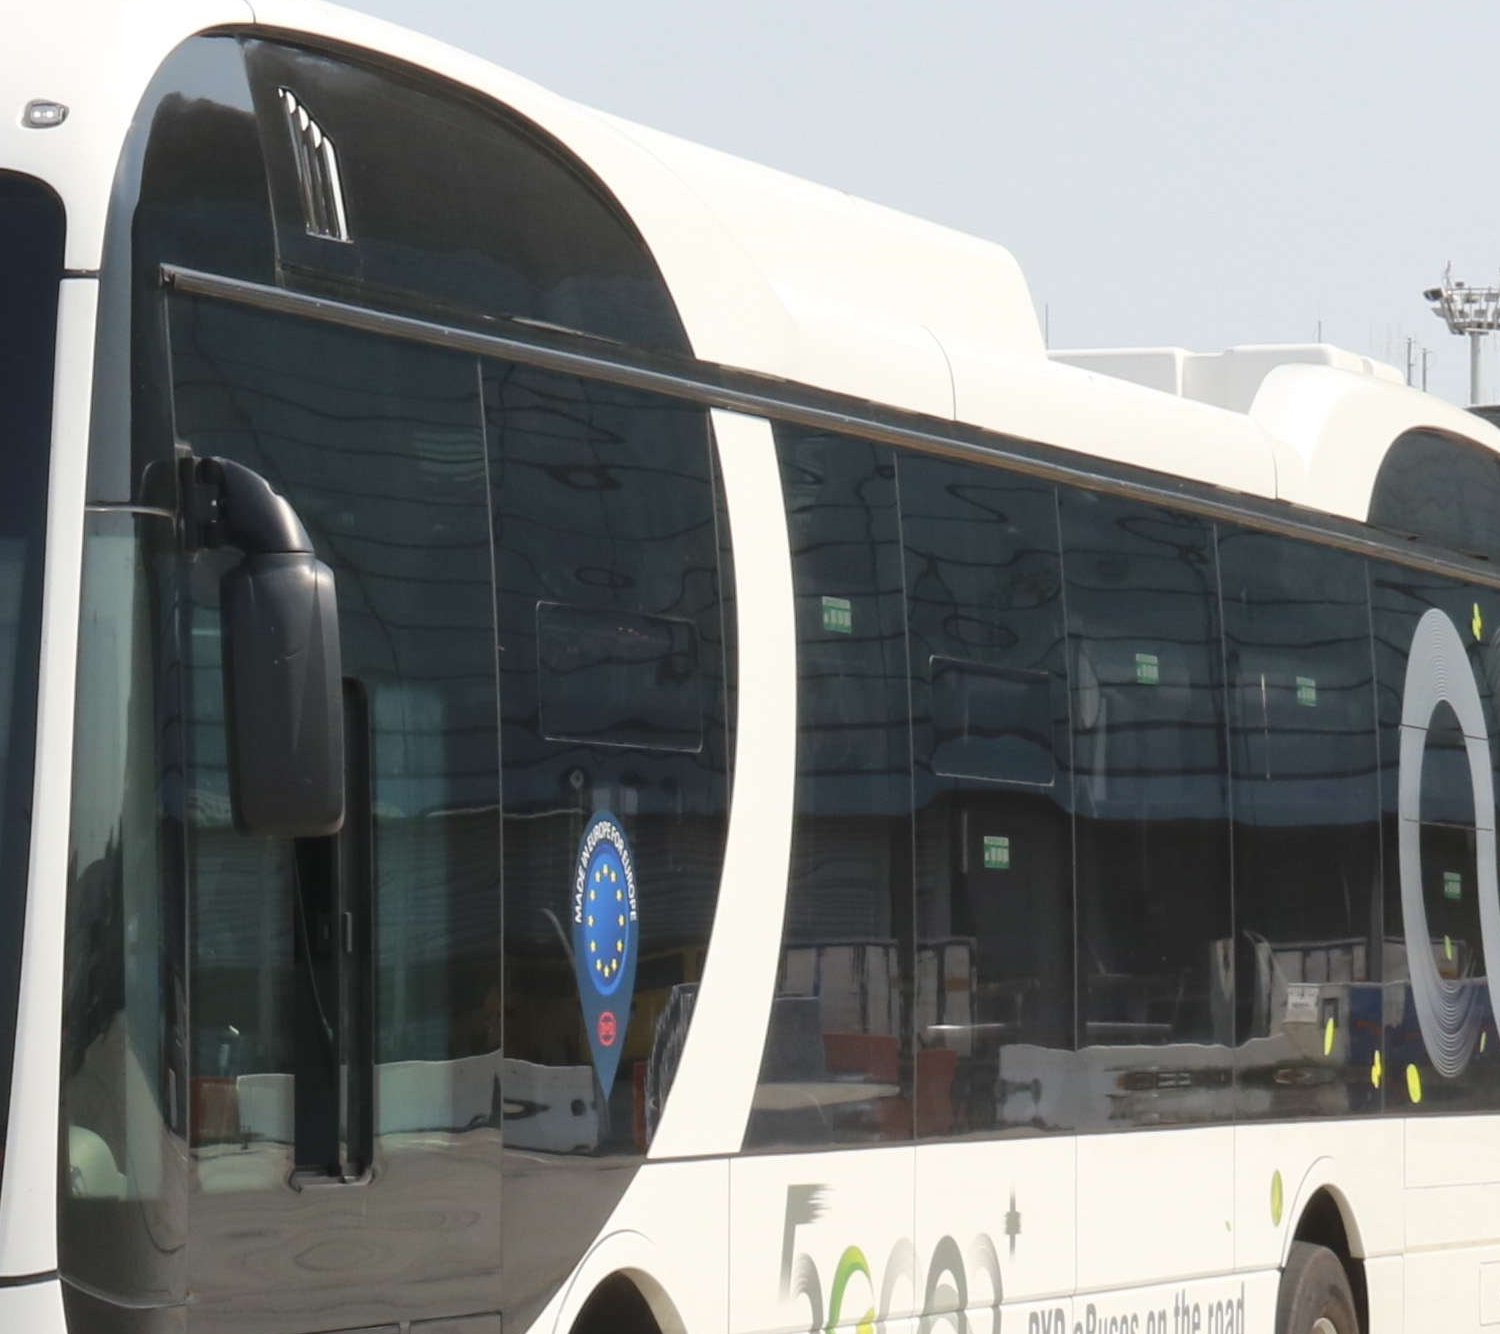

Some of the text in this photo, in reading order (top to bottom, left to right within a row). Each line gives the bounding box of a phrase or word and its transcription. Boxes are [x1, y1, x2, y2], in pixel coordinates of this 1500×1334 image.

[575, 865, 586, 923] MADE
[581, 845, 590, 868] IN
[621, 849, 637, 921] EUROPE
